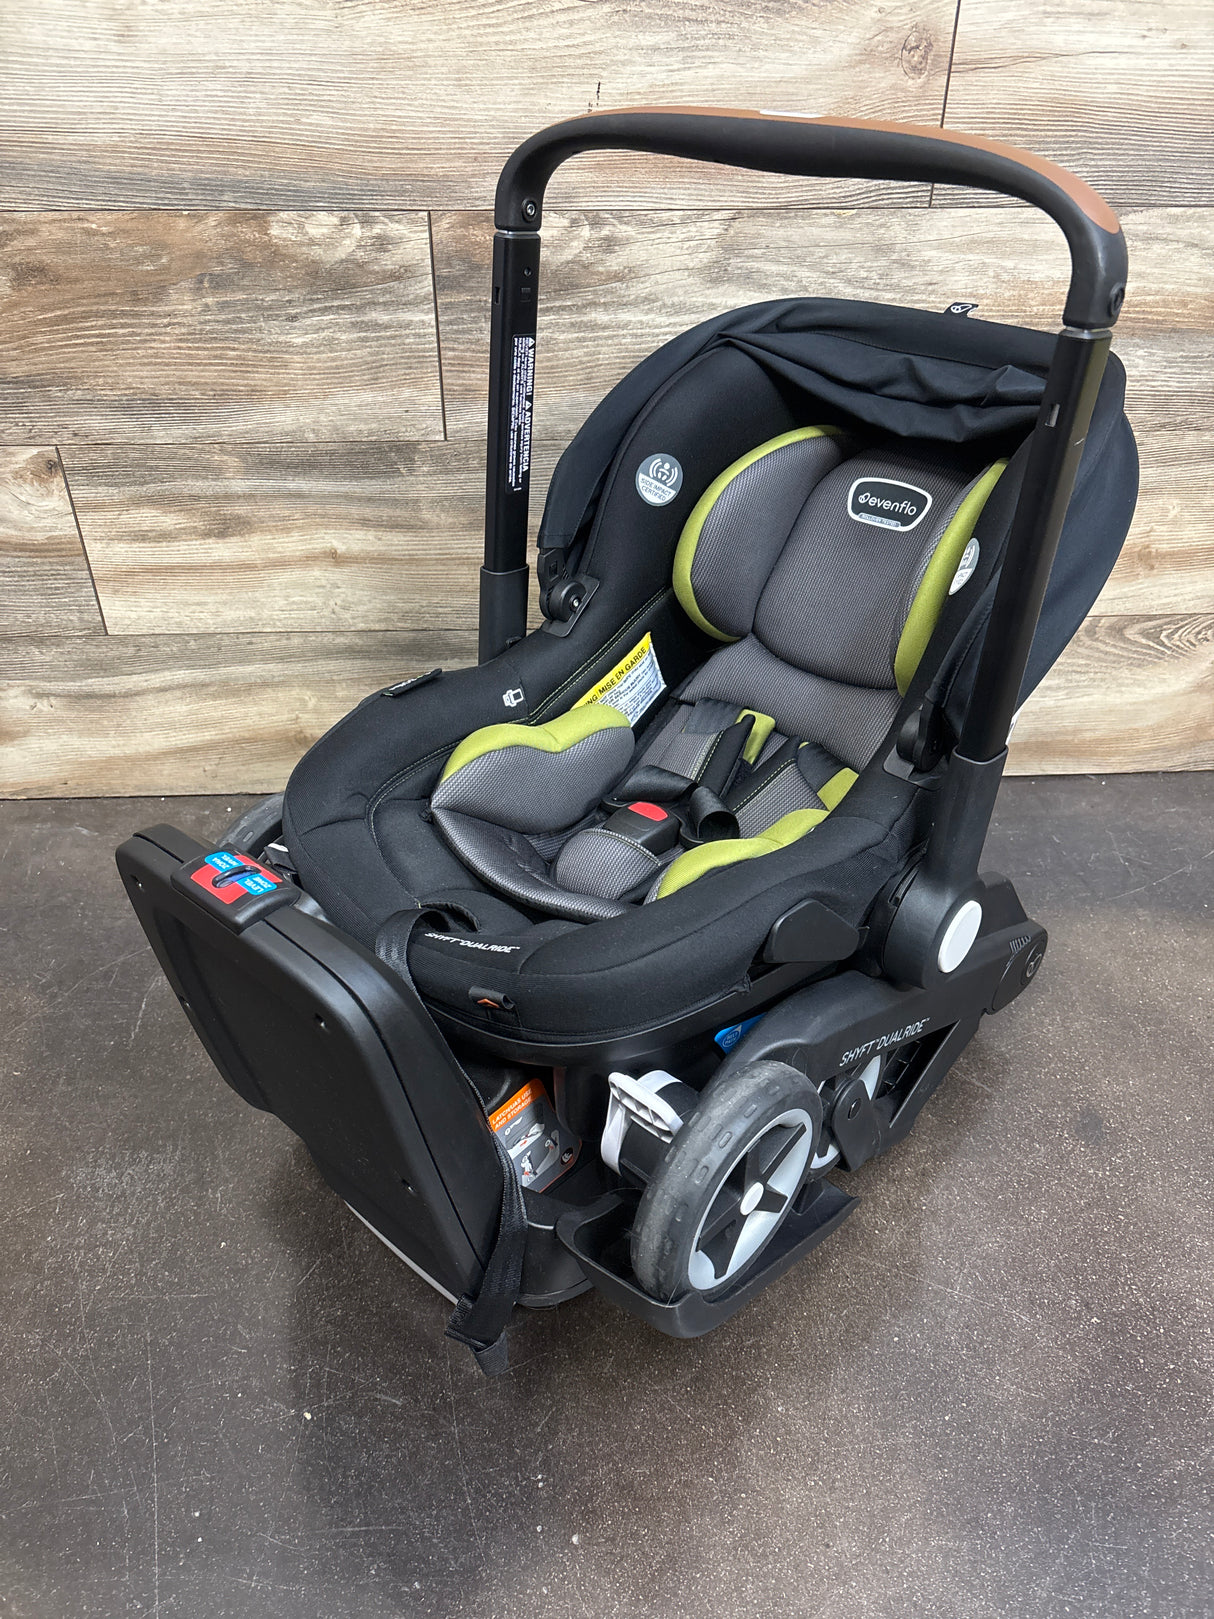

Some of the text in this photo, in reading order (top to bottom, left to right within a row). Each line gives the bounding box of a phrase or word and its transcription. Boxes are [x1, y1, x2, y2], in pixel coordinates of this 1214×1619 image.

[526, 348, 535, 396] WARNING!
[522, 411, 531, 472] ADVERTENCIA
[640, 478, 672, 497] SIDE IMPACT
[641, 485, 667, 502] CERTIFIED
[868, 495, 917, 516] evenflo
[598, 646, 647, 695] MISE EN GARDE
[244, 878, 265, 893] LEVEL
[253, 876, 272, 889] ZONE
[459, 939, 515, 954] DUALRIDE
[839, 1019, 927, 1067] SHYFT DUALRIDE
[494, 1096, 532, 1129] AND STORAGE
